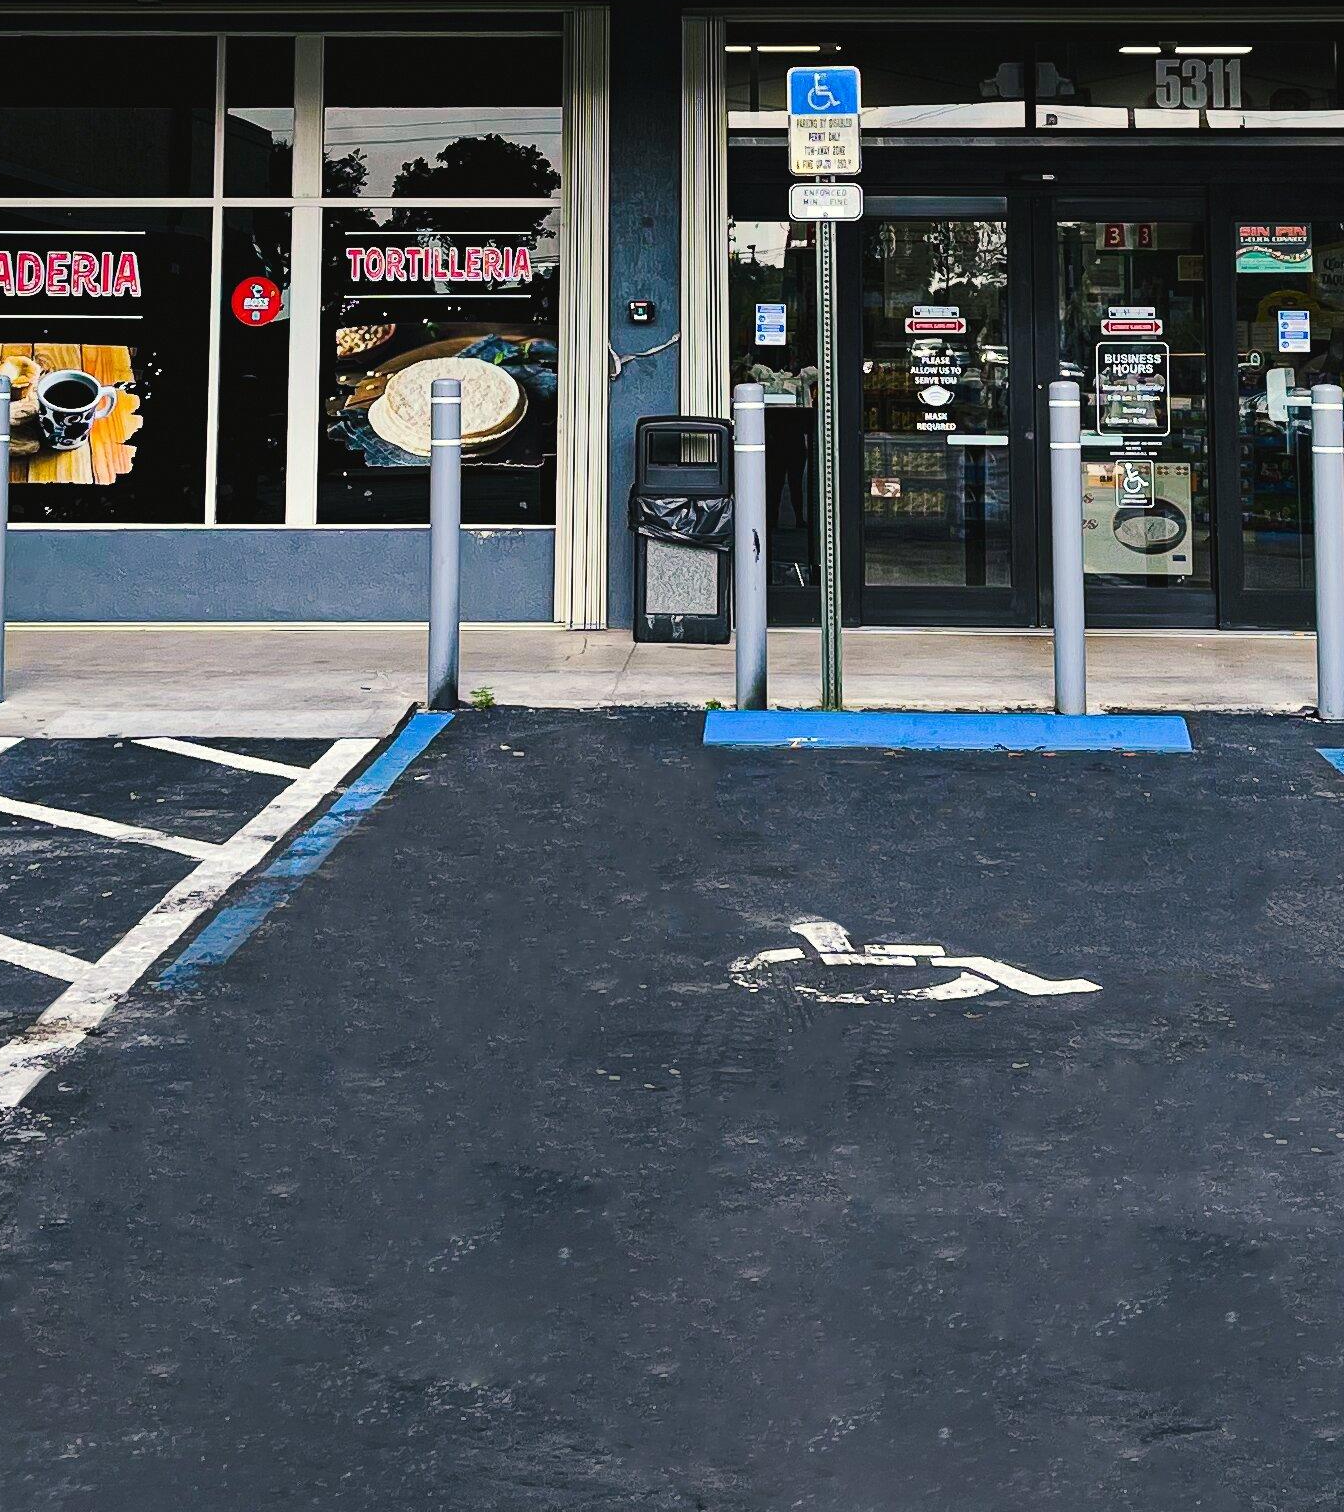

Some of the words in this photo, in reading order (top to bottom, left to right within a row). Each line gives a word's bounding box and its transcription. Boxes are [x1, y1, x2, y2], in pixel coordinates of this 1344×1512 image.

[1156, 58, 1242, 109] 5311
[345, 246, 533, 282] TORTILLERIA
[921, 356, 951, 365] PLEASE
[1104, 353, 1162, 365] BUSINESS
[910, 367, 938, 375] ALLOW
[938, 367, 951, 375] US
[951, 367, 962, 375] TO
[1112, 363, 1155, 375] HOURS
[914, 376, 940, 385] SERVE
[940, 376, 958, 385] YOU
[924, 412, 948, 421] MASK
[916, 422, 957, 431] REQUIRED
